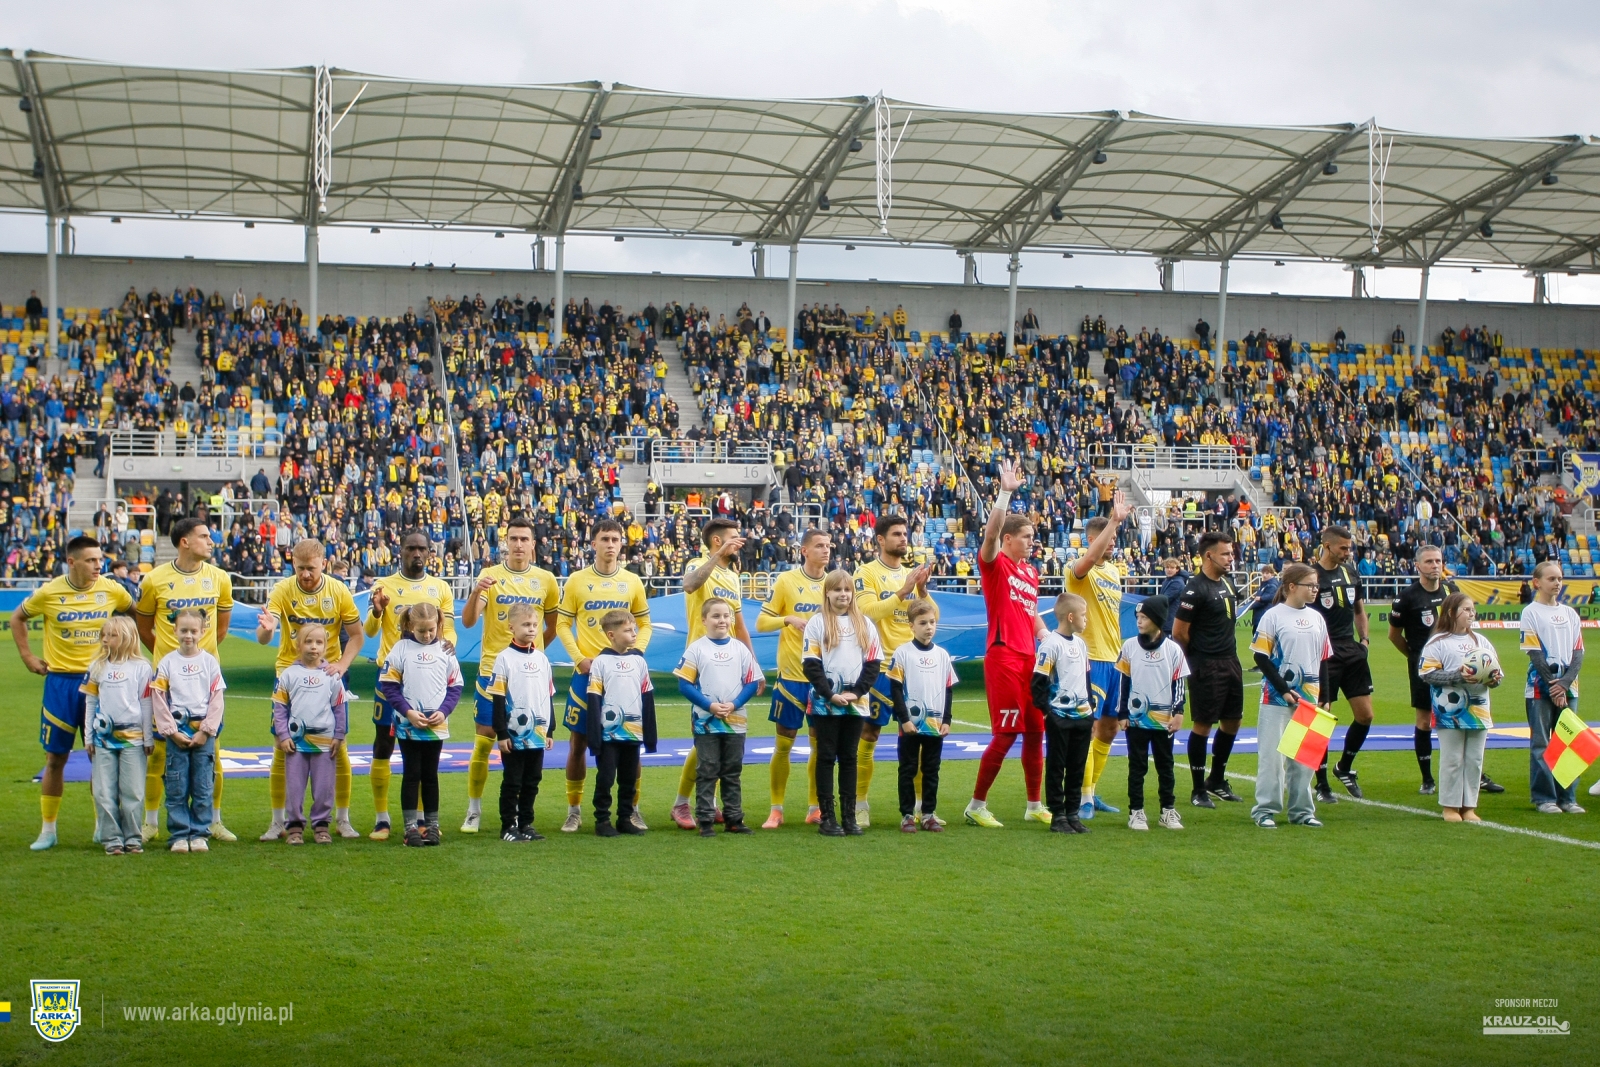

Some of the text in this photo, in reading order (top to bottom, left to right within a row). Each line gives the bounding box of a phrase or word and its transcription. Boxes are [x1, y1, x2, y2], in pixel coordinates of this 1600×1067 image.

[122, 458, 134, 472] G
[215, 459, 233, 473] 15
[662, 464, 672, 477] H
[743, 465, 759, 479] 16
[1142, 470, 1152, 481] H
[1214, 471, 1228, 483] 17
[166, 597, 216, 610] GDYNIA
[496, 594, 542, 606] GDYNIA
[584, 600, 630, 611] GDYNIA
[57, 611, 108, 622] GDYNIA
[73, 630, 100, 640] Energ
[565, 705, 581, 726] 35
[999, 709, 1019, 728] 77
